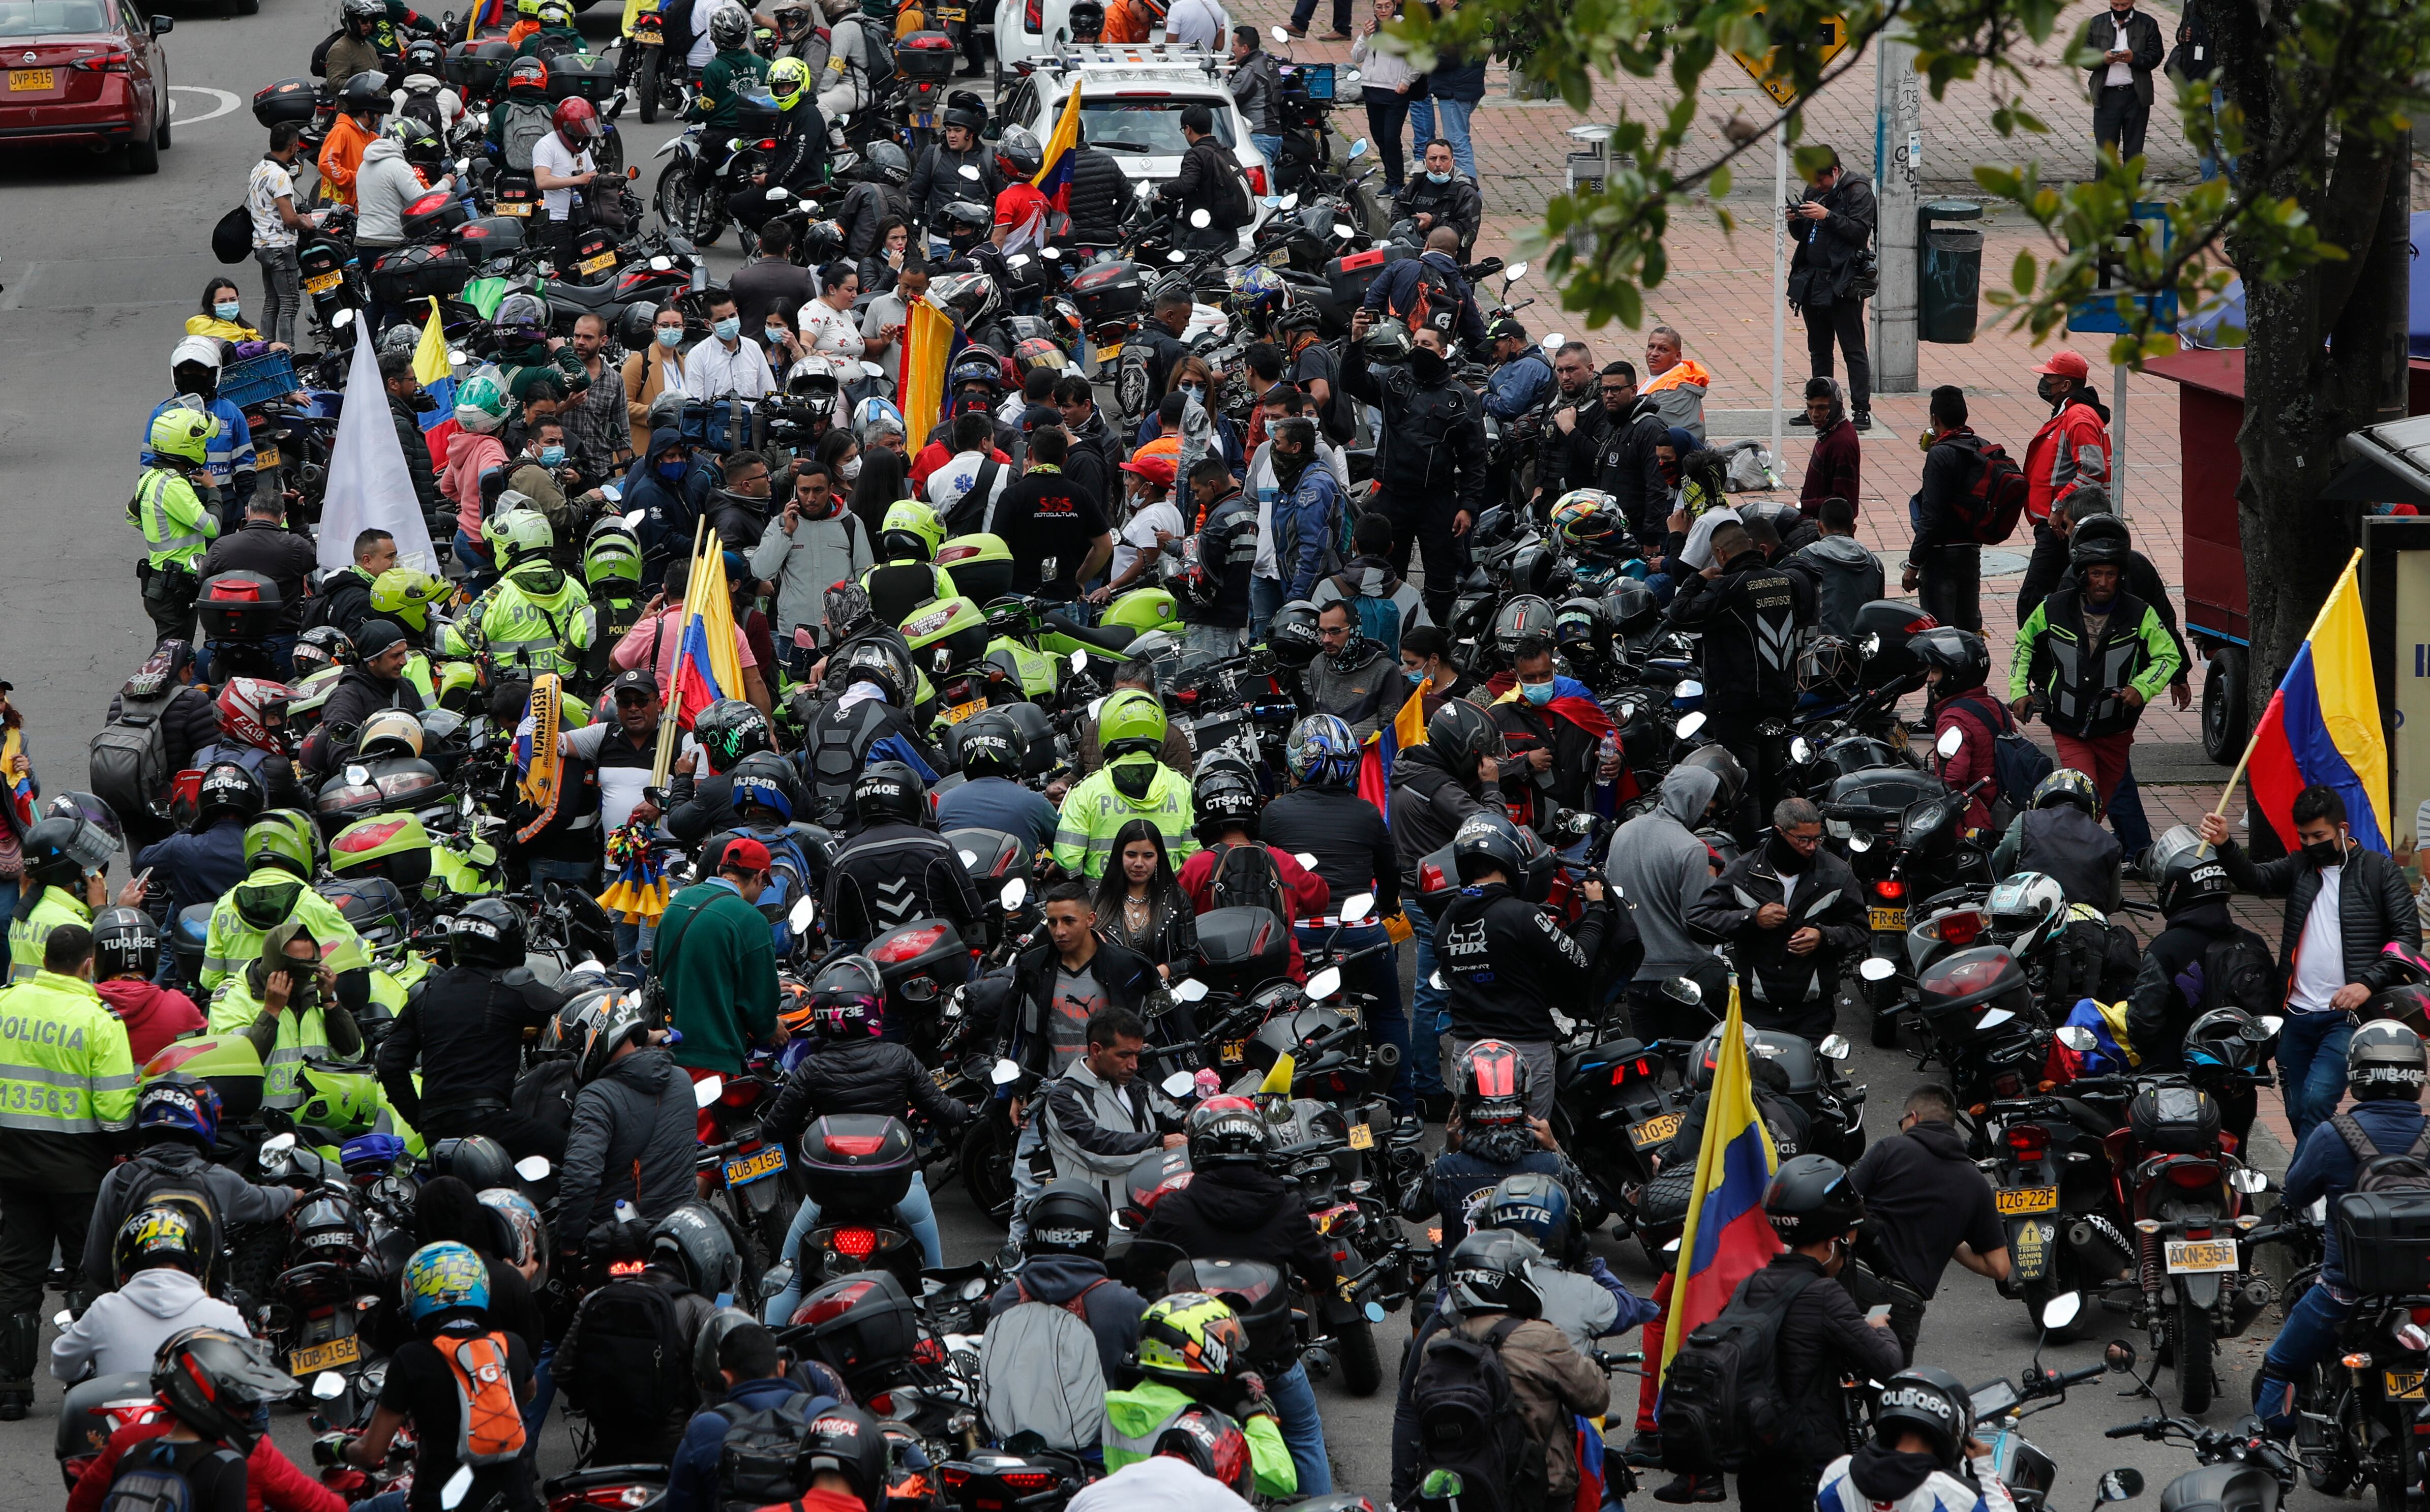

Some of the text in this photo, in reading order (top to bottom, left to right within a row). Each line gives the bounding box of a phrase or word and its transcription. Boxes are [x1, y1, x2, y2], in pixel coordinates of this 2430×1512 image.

[11, 70, 51, 84] JVP 515
[581, 253, 614, 273] BNC 66G
[1272, 252, 1286, 263] 84B
[306, 279, 322, 291] CTR
[1039, 497, 1072, 511] SOS
[1756, 595, 1791, 609] SUPERVISOR
[910, 611, 948, 630] TRANSITO
[1119, 704, 1160, 722] POLICIA
[233, 715, 266, 742] F-A18
[531, 687, 547, 759] RESISTENCIA
[855, 784, 899, 801] PMY40E
[1206, 794, 1253, 810] CTS41C
[1442, 941, 1488, 956] FOX
[815, 1005, 864, 1020] LTT73E
[0, 1016, 83, 1051] OLICIA
[1211, 1120, 1264, 1142] YUR68D
[341, 1146, 362, 1157] HONDA
[726, 1150, 782, 1181] CUB 15G
[1998, 1189, 2055, 1209] IZG 22F
[1490, 1206, 1551, 1224] TLL77E
[2017, 1245, 2042, 1253] YESHUA
[2017, 1253, 2043, 1261] CAMINO
[2170, 1247, 2231, 1265] AKN 35F
[2017, 1261, 2042, 1269] VERDAD
[292, 1341, 357, 1369] YOB 15E
